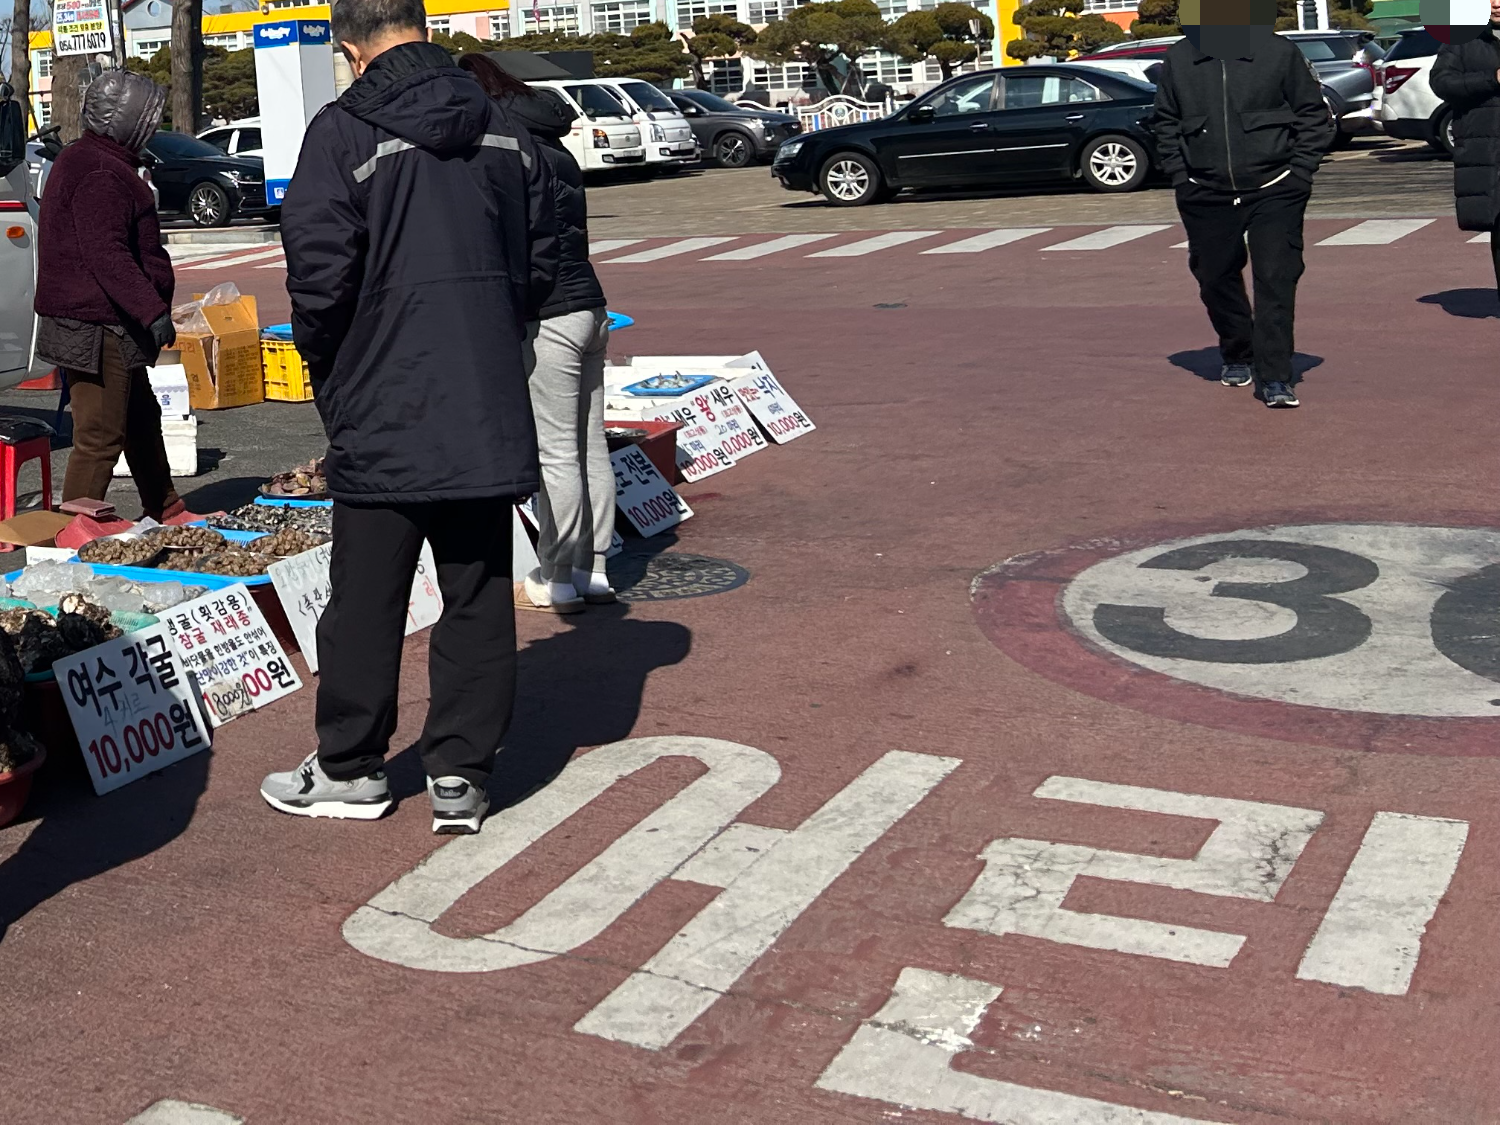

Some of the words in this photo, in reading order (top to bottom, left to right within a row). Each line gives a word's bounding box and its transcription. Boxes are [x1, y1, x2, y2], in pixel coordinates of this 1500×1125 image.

[710, 385, 734, 407] 새우
[671, 407, 697, 427] 새우
[767, 410, 811, 436] 10,000원
[619, 449, 660, 486] 전복
[680, 447, 732, 476] 10,000원
[627, 488, 688, 529] 10,000원
[67, 656, 123, 717] 여수
[121, 634, 180, 695] 각굴
[88, 698, 202, 779] 10,000원
